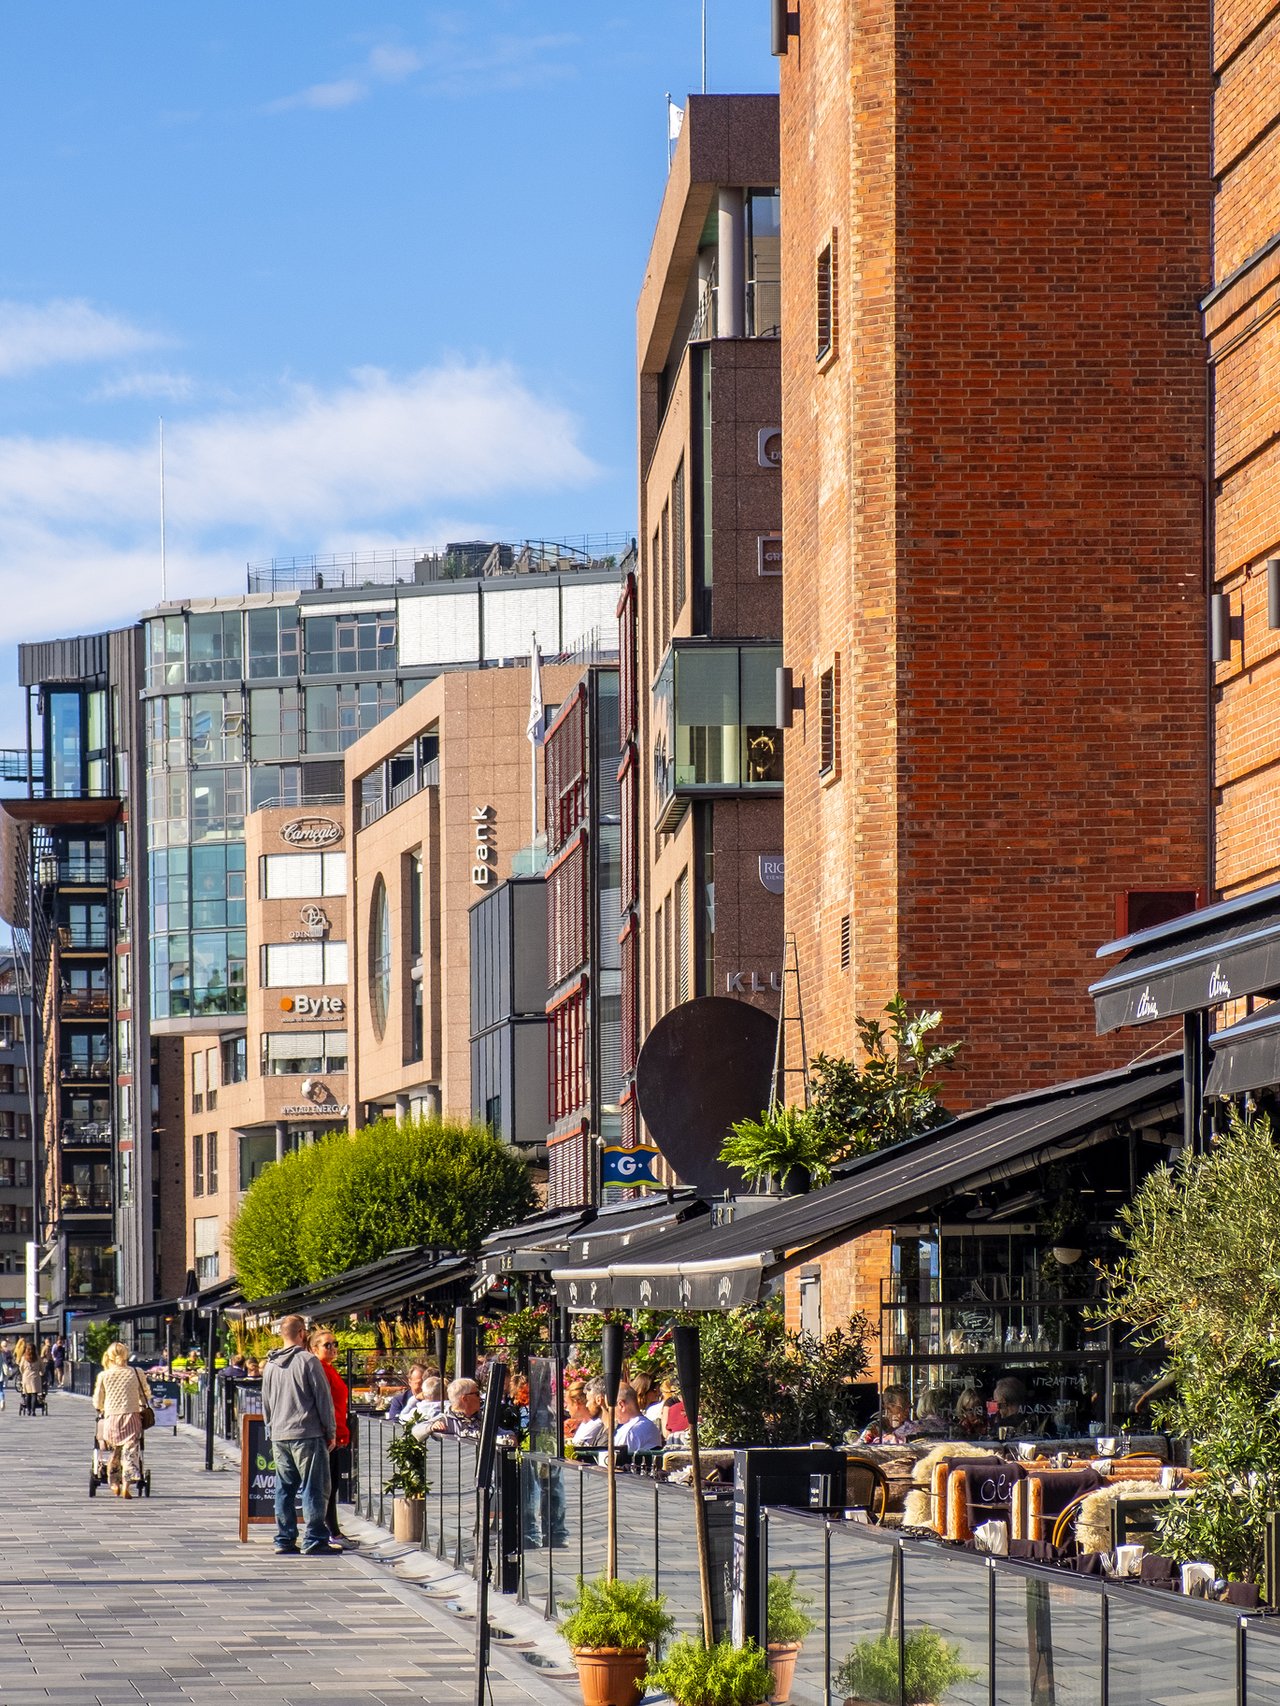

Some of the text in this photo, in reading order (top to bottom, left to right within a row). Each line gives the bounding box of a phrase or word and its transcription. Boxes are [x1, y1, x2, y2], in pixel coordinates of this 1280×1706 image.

[283, 823, 337, 843] Carnegie
[471, 805, 488, 884] Bank
[295, 994, 343, 1017] Byte
